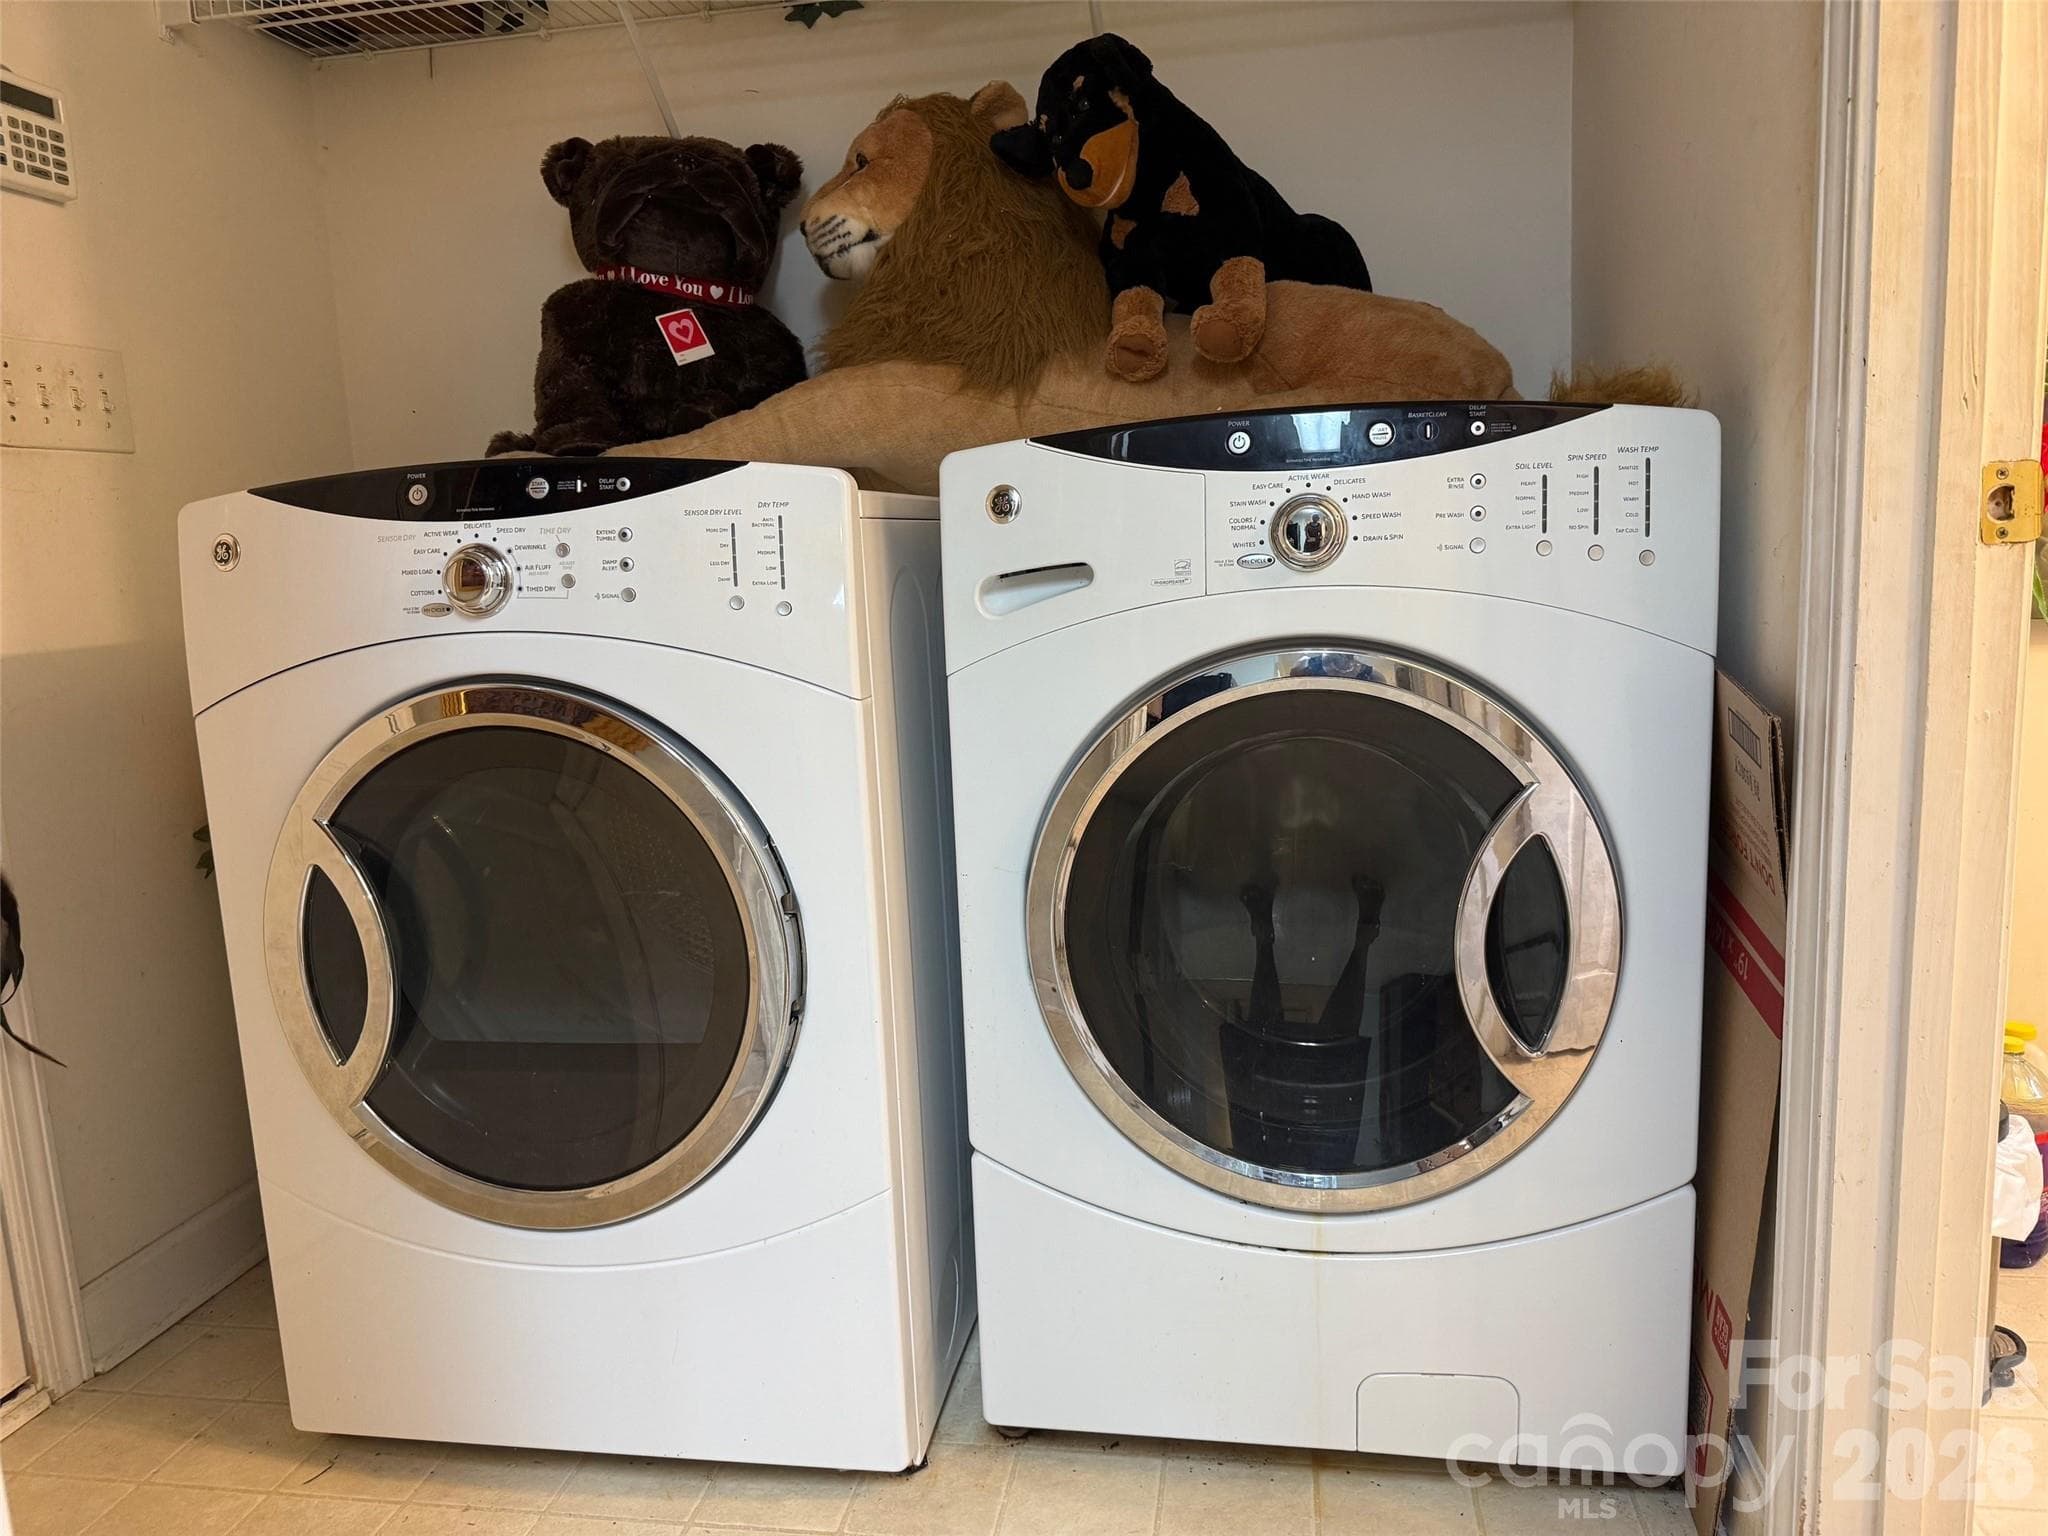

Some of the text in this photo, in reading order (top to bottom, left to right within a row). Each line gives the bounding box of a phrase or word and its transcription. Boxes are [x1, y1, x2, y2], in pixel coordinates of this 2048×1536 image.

[630, 267, 669, 286] Love
[674, 275, 703, 297] You
[728, 286, 735, 303] I
[377, 535, 402, 543] SENSOR
[1232, 541, 1256, 549] WHITES
